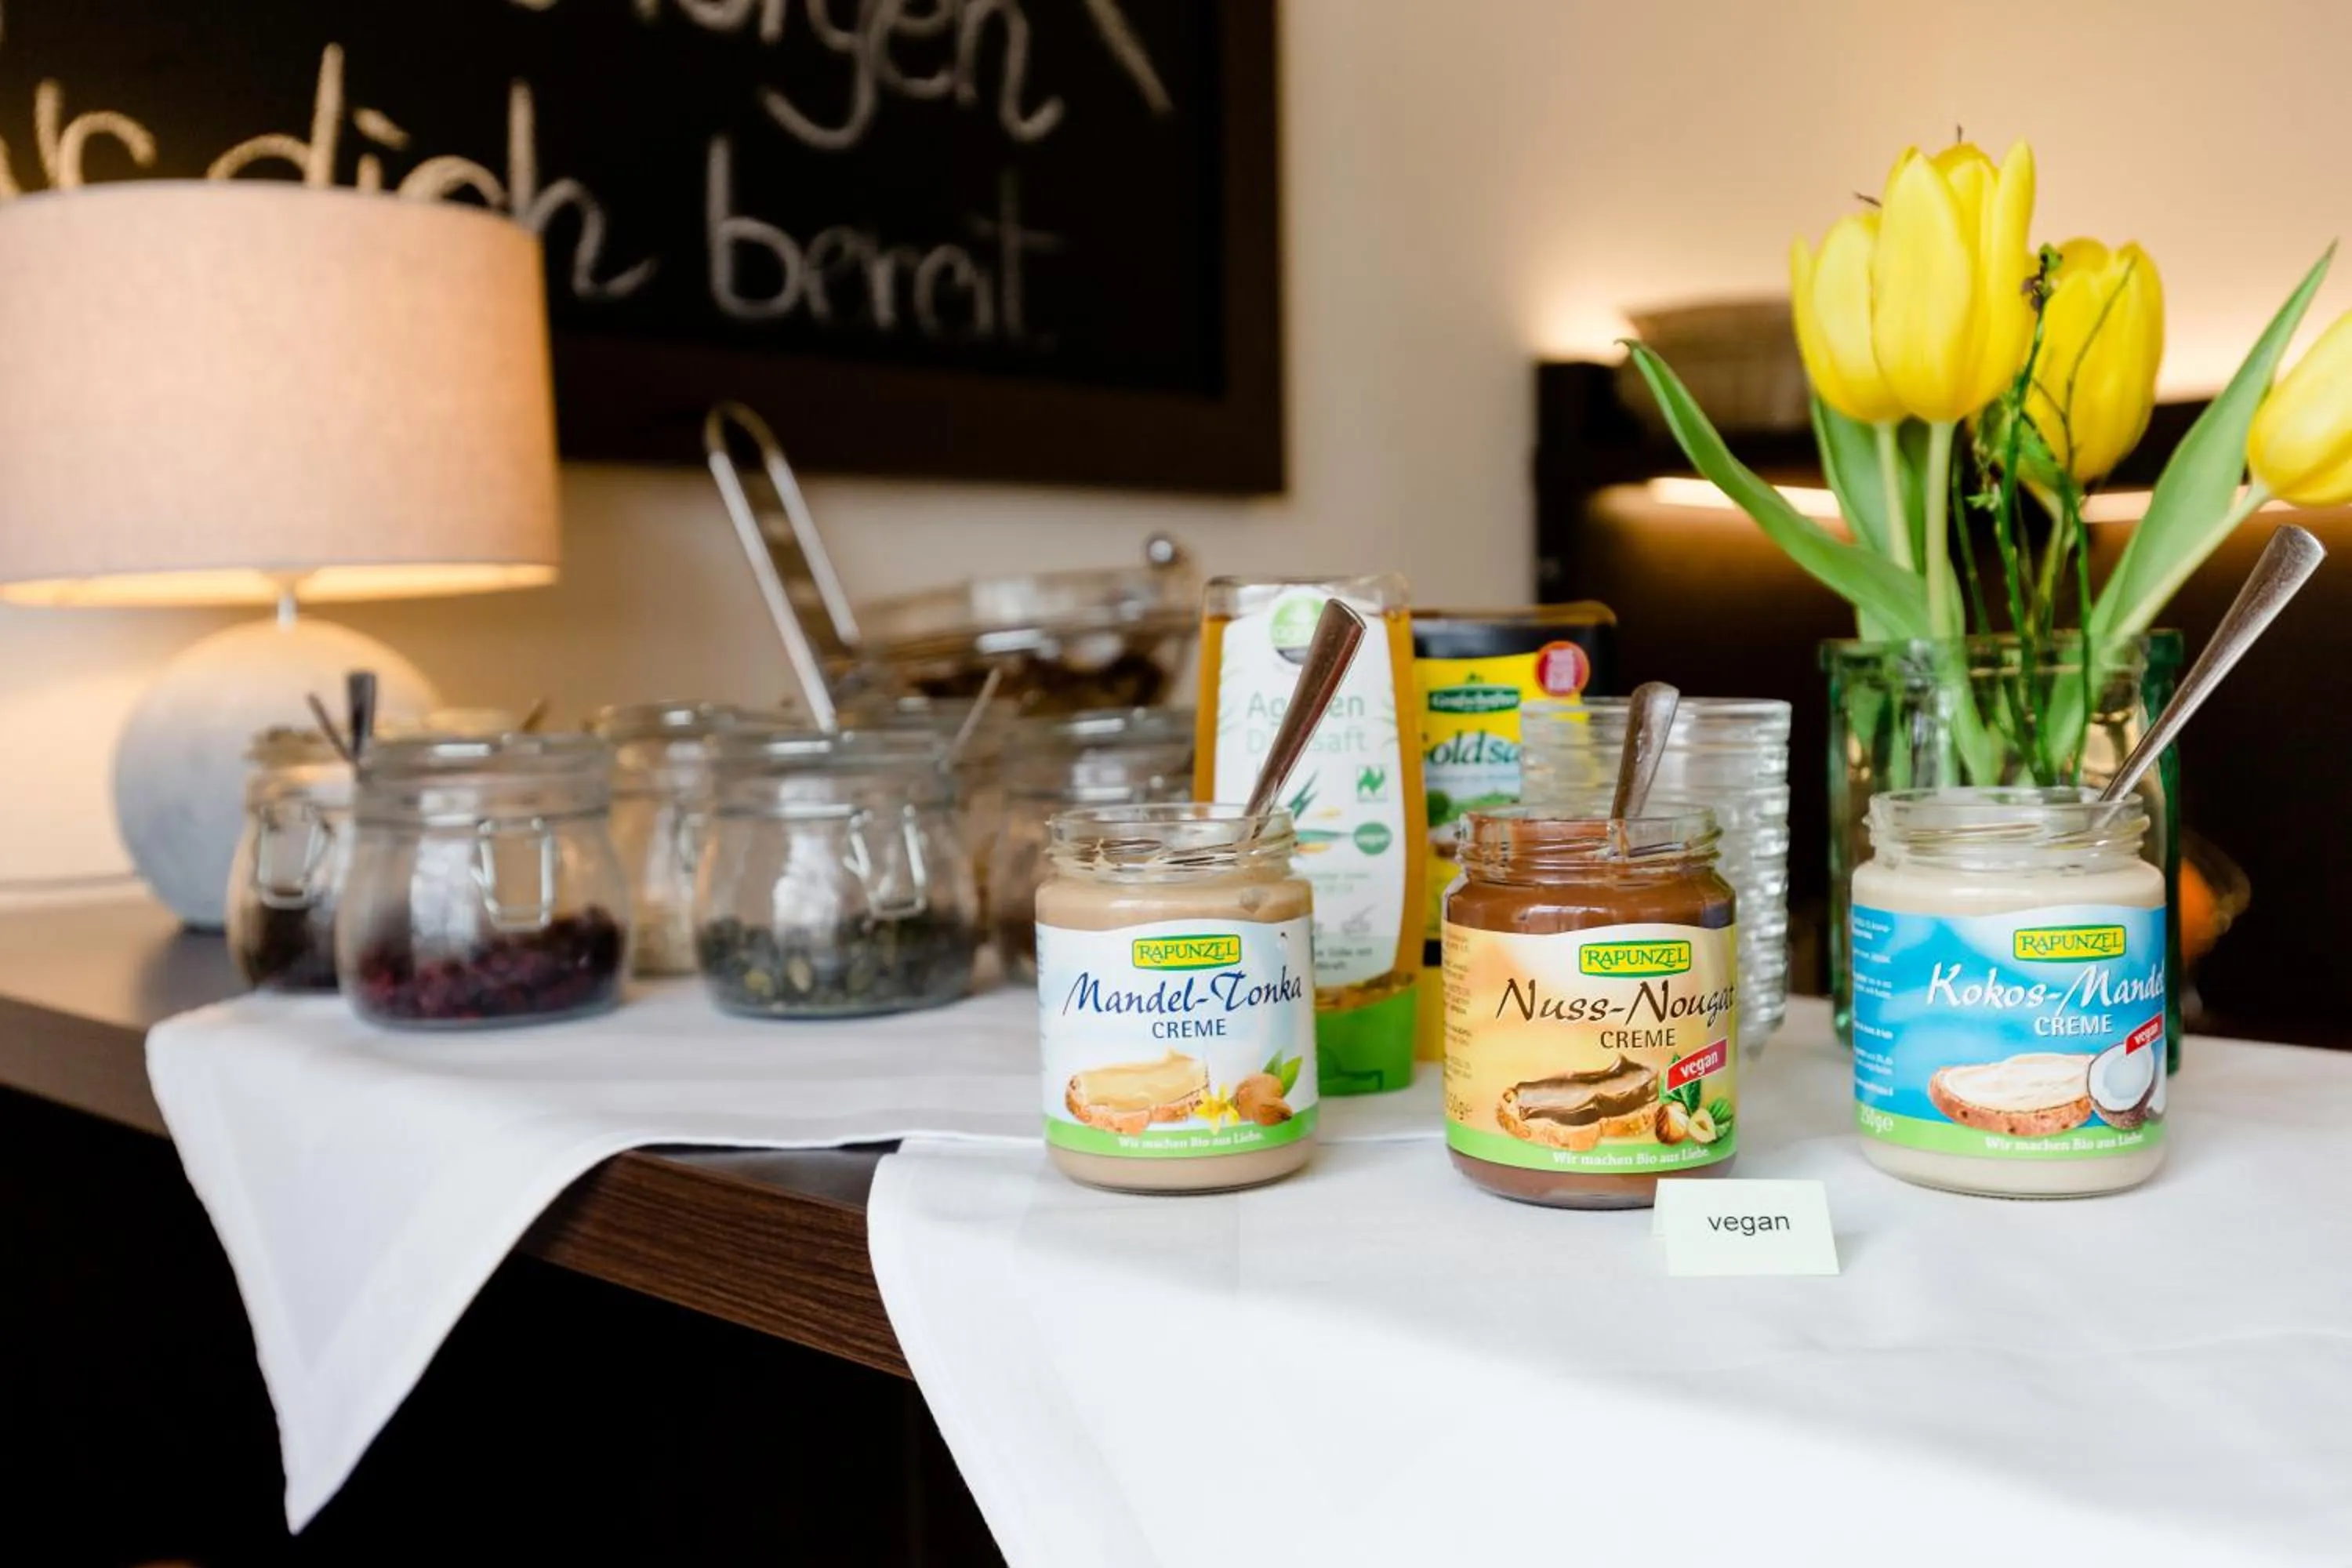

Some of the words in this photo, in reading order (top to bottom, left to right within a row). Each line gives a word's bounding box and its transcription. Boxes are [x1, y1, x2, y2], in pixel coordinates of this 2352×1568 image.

[1247, 689, 1365, 725] Agen
[1247, 726, 1369, 754] Dsaft
[1138, 941, 1237, 964] RAPUNZEL
[2020, 932, 2122, 955] RAPUNZEL
[1584, 946, 1688, 970] RAPUNZEL
[1062, 966, 1303, 1016] Mandel-Tonka
[1496, 978, 1735, 1026] Nuss-Nougat
[1152, 1018, 1227, 1039] CREME
[2034, 1014, 2114, 1036] CREME
[1600, 1029, 1676, 1049] CREME
[1680, 1050, 1719, 1078] vegan
[1553, 1151, 1577, 1163] Wir
[1581, 1153, 1633, 1165] machen
[1707, 1215, 1791, 1236] vegan
